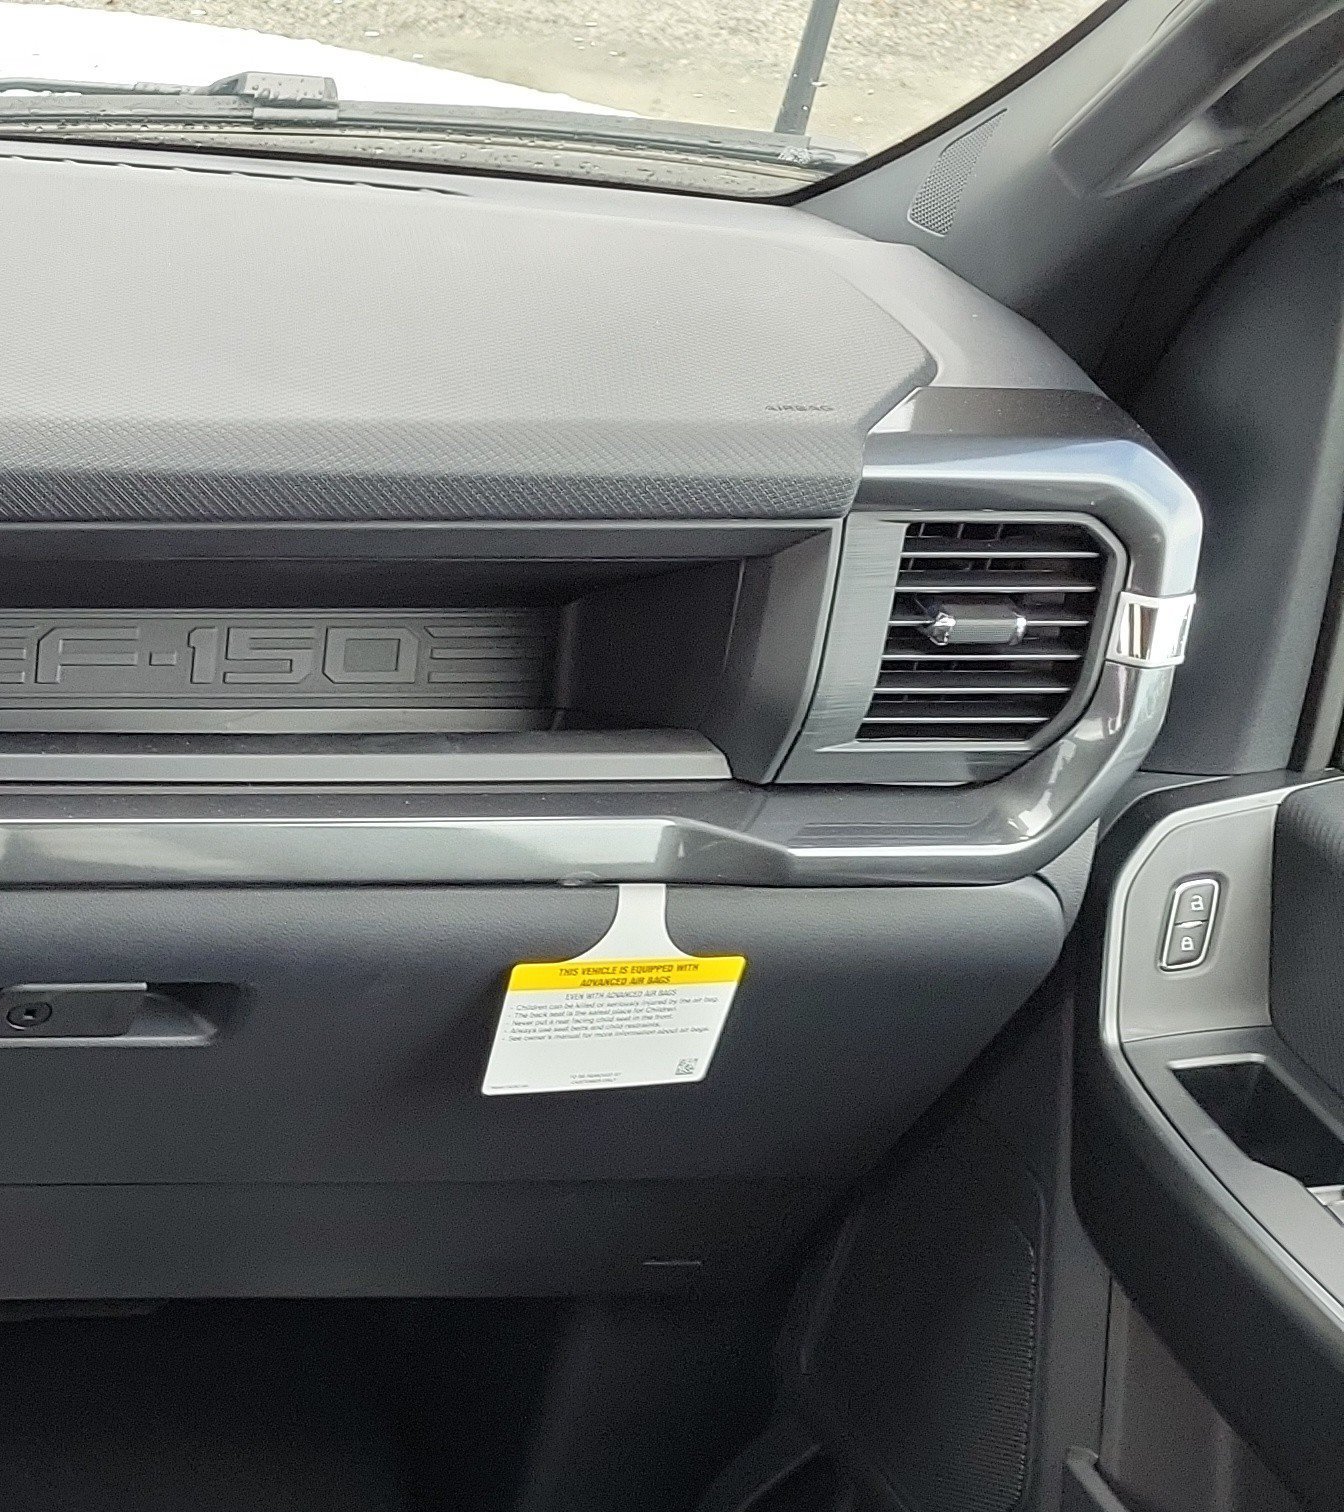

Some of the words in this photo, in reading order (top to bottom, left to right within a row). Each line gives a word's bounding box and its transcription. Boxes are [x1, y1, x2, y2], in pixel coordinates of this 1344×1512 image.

[764, 404, 836, 413] AIRBAG
[35, 625, 424, 686] F-150
[559, 968, 579, 977] THIS
[581, 966, 617, 976] VEHICLE
[619, 966, 628, 974] IS
[630, 964, 674, 974] EQUIPPED
[676, 963, 699, 972] WITH
[580, 977, 627, 987] ADVANCED
[629, 977, 645, 985] AIR
[647, 976, 671, 985] BAGS
[565, 992, 584, 1001] EVEN
[606, 991, 643, 999] ADVANCED
[657, 989, 677, 997] BAGS
